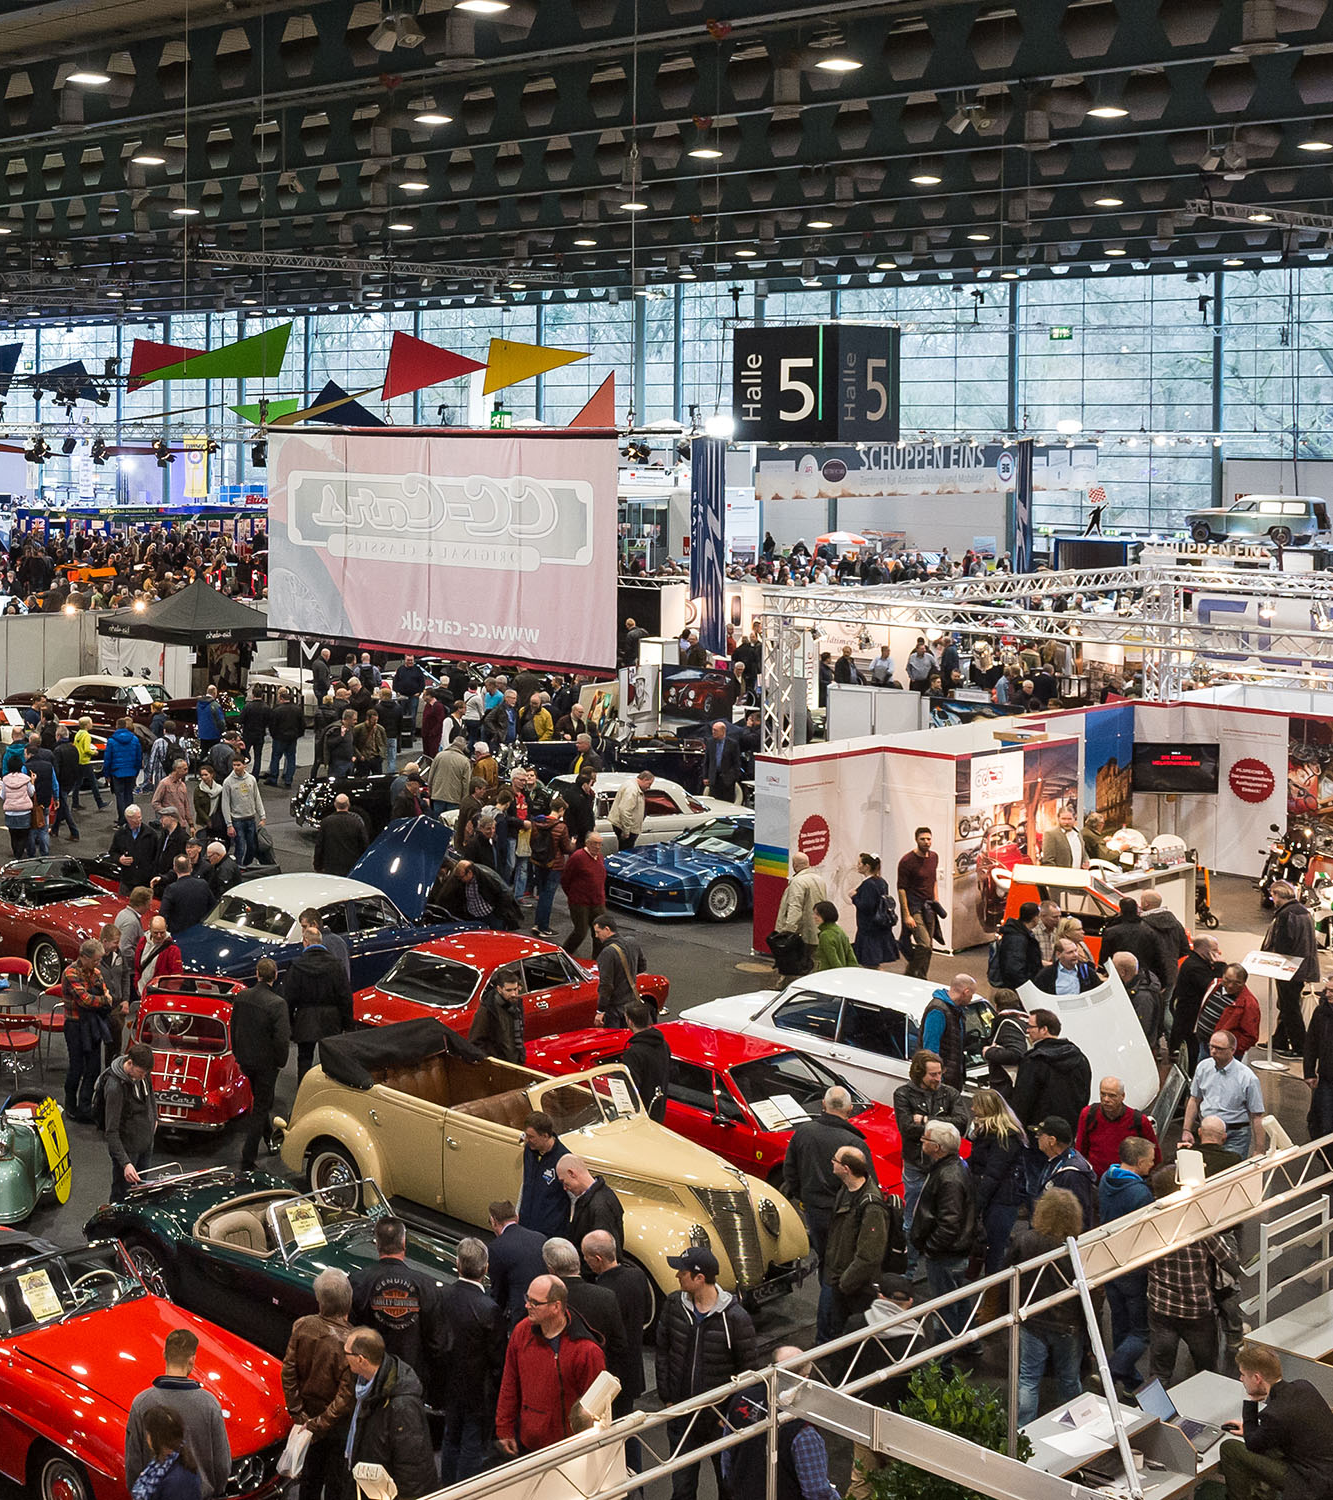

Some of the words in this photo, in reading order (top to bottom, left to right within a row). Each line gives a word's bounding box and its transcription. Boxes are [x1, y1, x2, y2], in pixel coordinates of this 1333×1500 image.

[741, 353, 762, 421] Halle
[779, 358, 815, 421] 5
[842, 352, 857, 421] Halle
[866, 358, 888, 421] 5
[859, 444, 944, 471] SCHUPPEN
[950, 443, 985, 469] EINS
[375, 1277, 415, 1292] GENUINE
